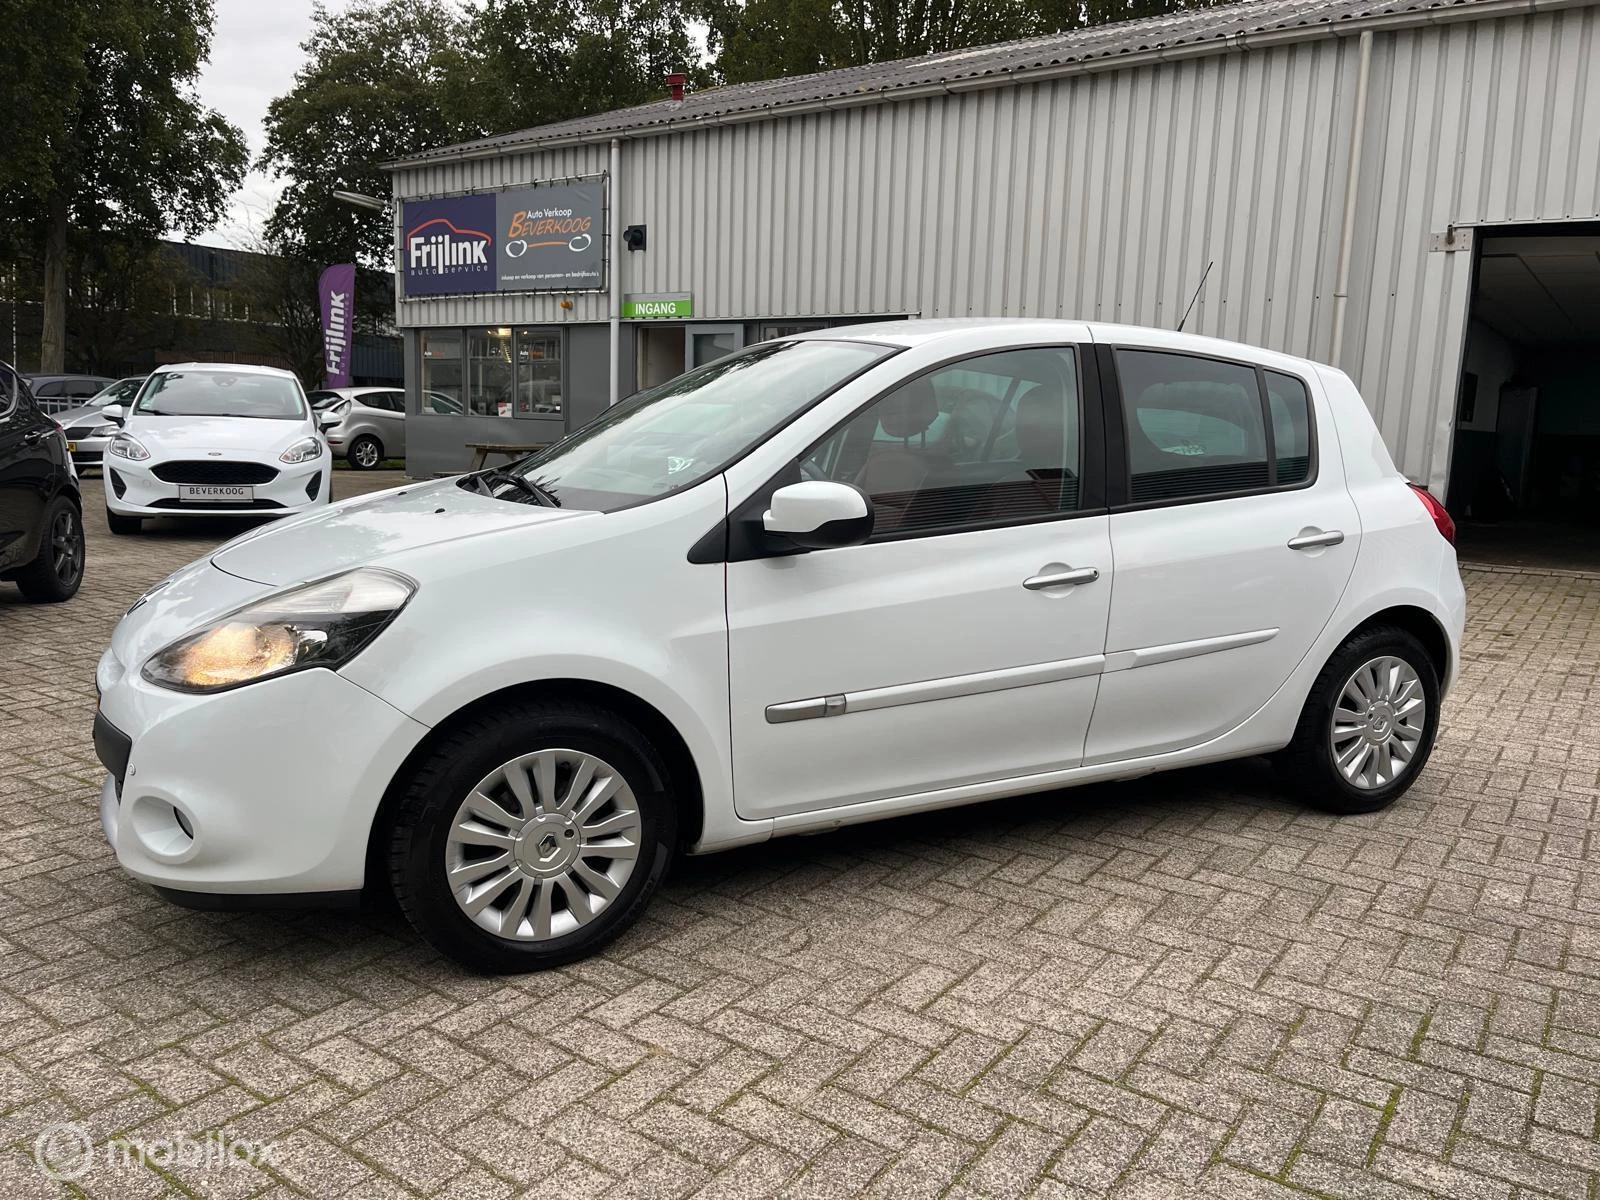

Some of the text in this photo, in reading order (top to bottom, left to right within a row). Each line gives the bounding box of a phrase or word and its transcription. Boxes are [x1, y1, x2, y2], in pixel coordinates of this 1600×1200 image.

[527, 207, 573, 219] Auto Verkoop
[508, 211, 592, 238] BEVERKOOG
[410, 235, 488, 275] Frijlink
[635, 302, 676, 315] INGANG
[325, 290, 347, 375] Frijlink
[189, 487, 244, 495] BEVERKOOG
